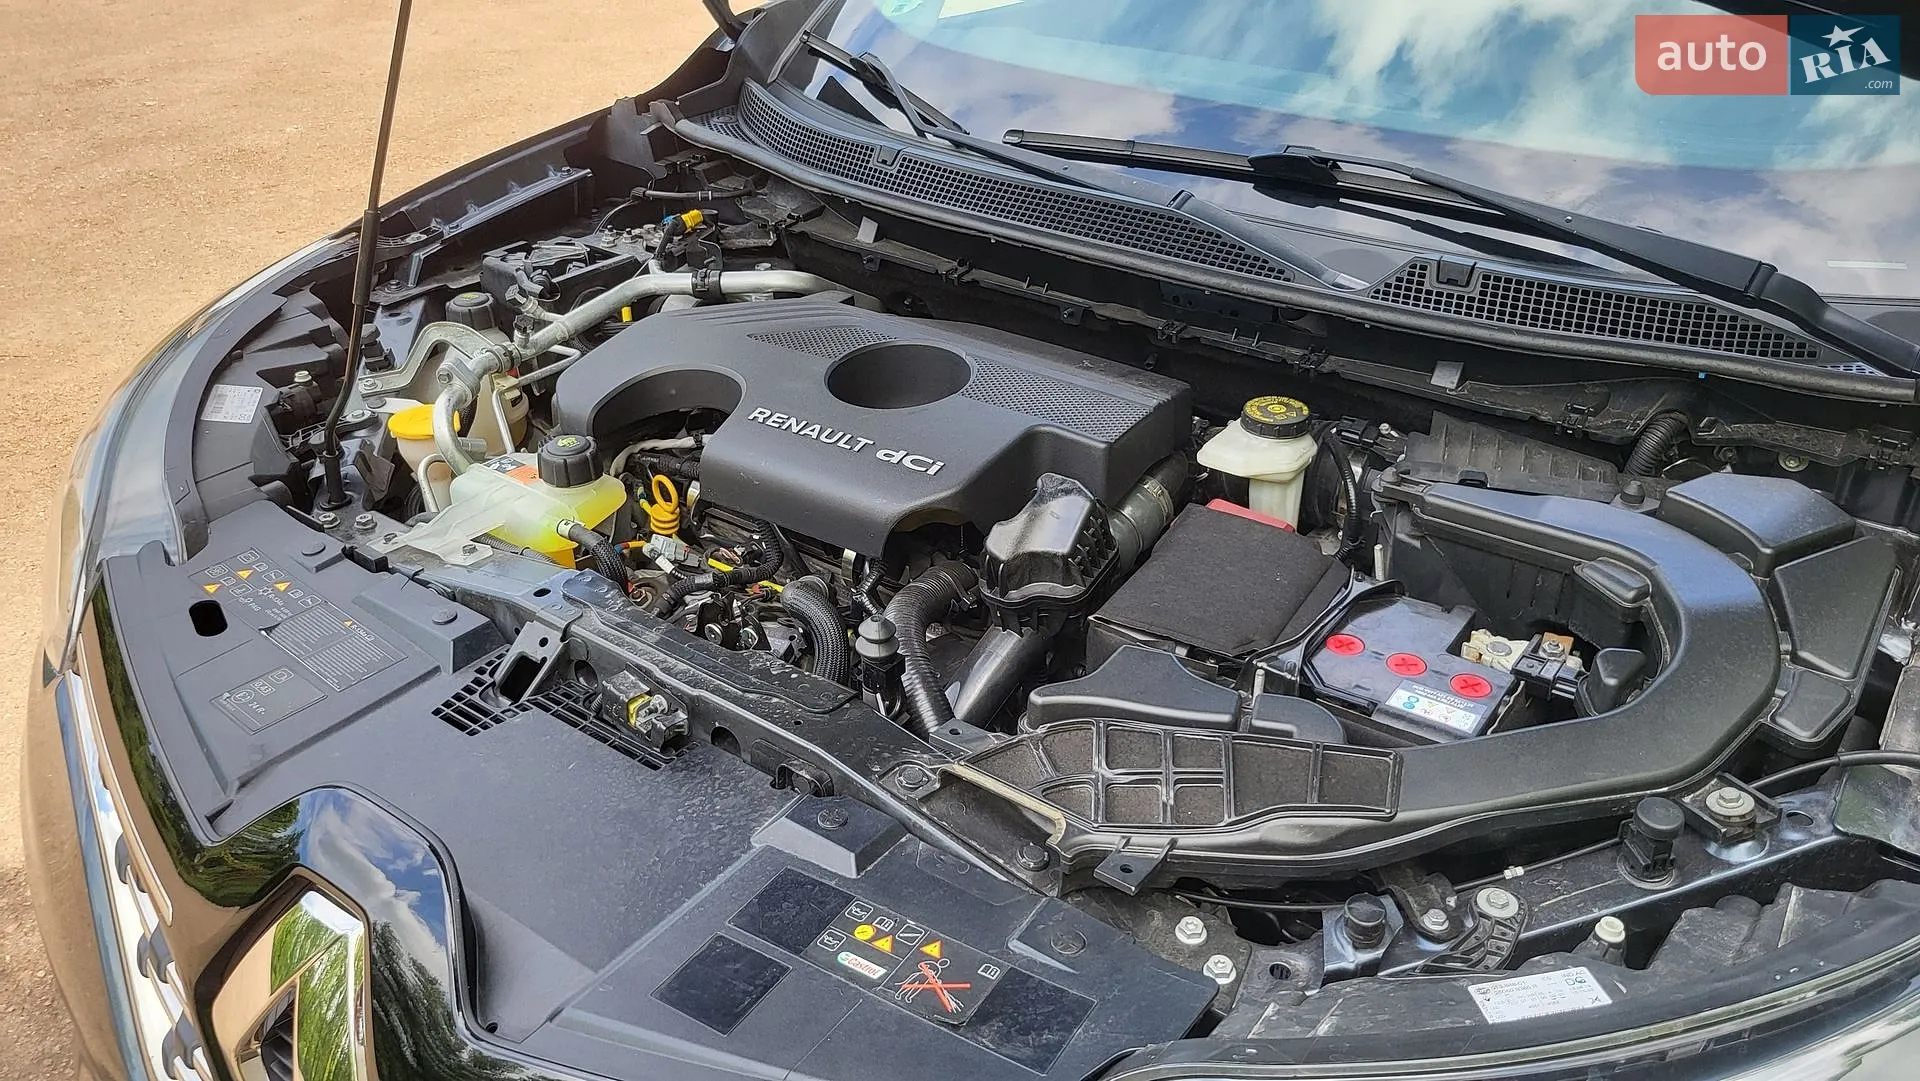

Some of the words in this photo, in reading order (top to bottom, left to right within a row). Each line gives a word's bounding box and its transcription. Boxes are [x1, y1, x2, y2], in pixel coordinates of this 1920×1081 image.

[748, 407, 875, 453] RENAULT
[876, 449, 946, 476] dCi
[847, 957, 881, 977] Castrol
